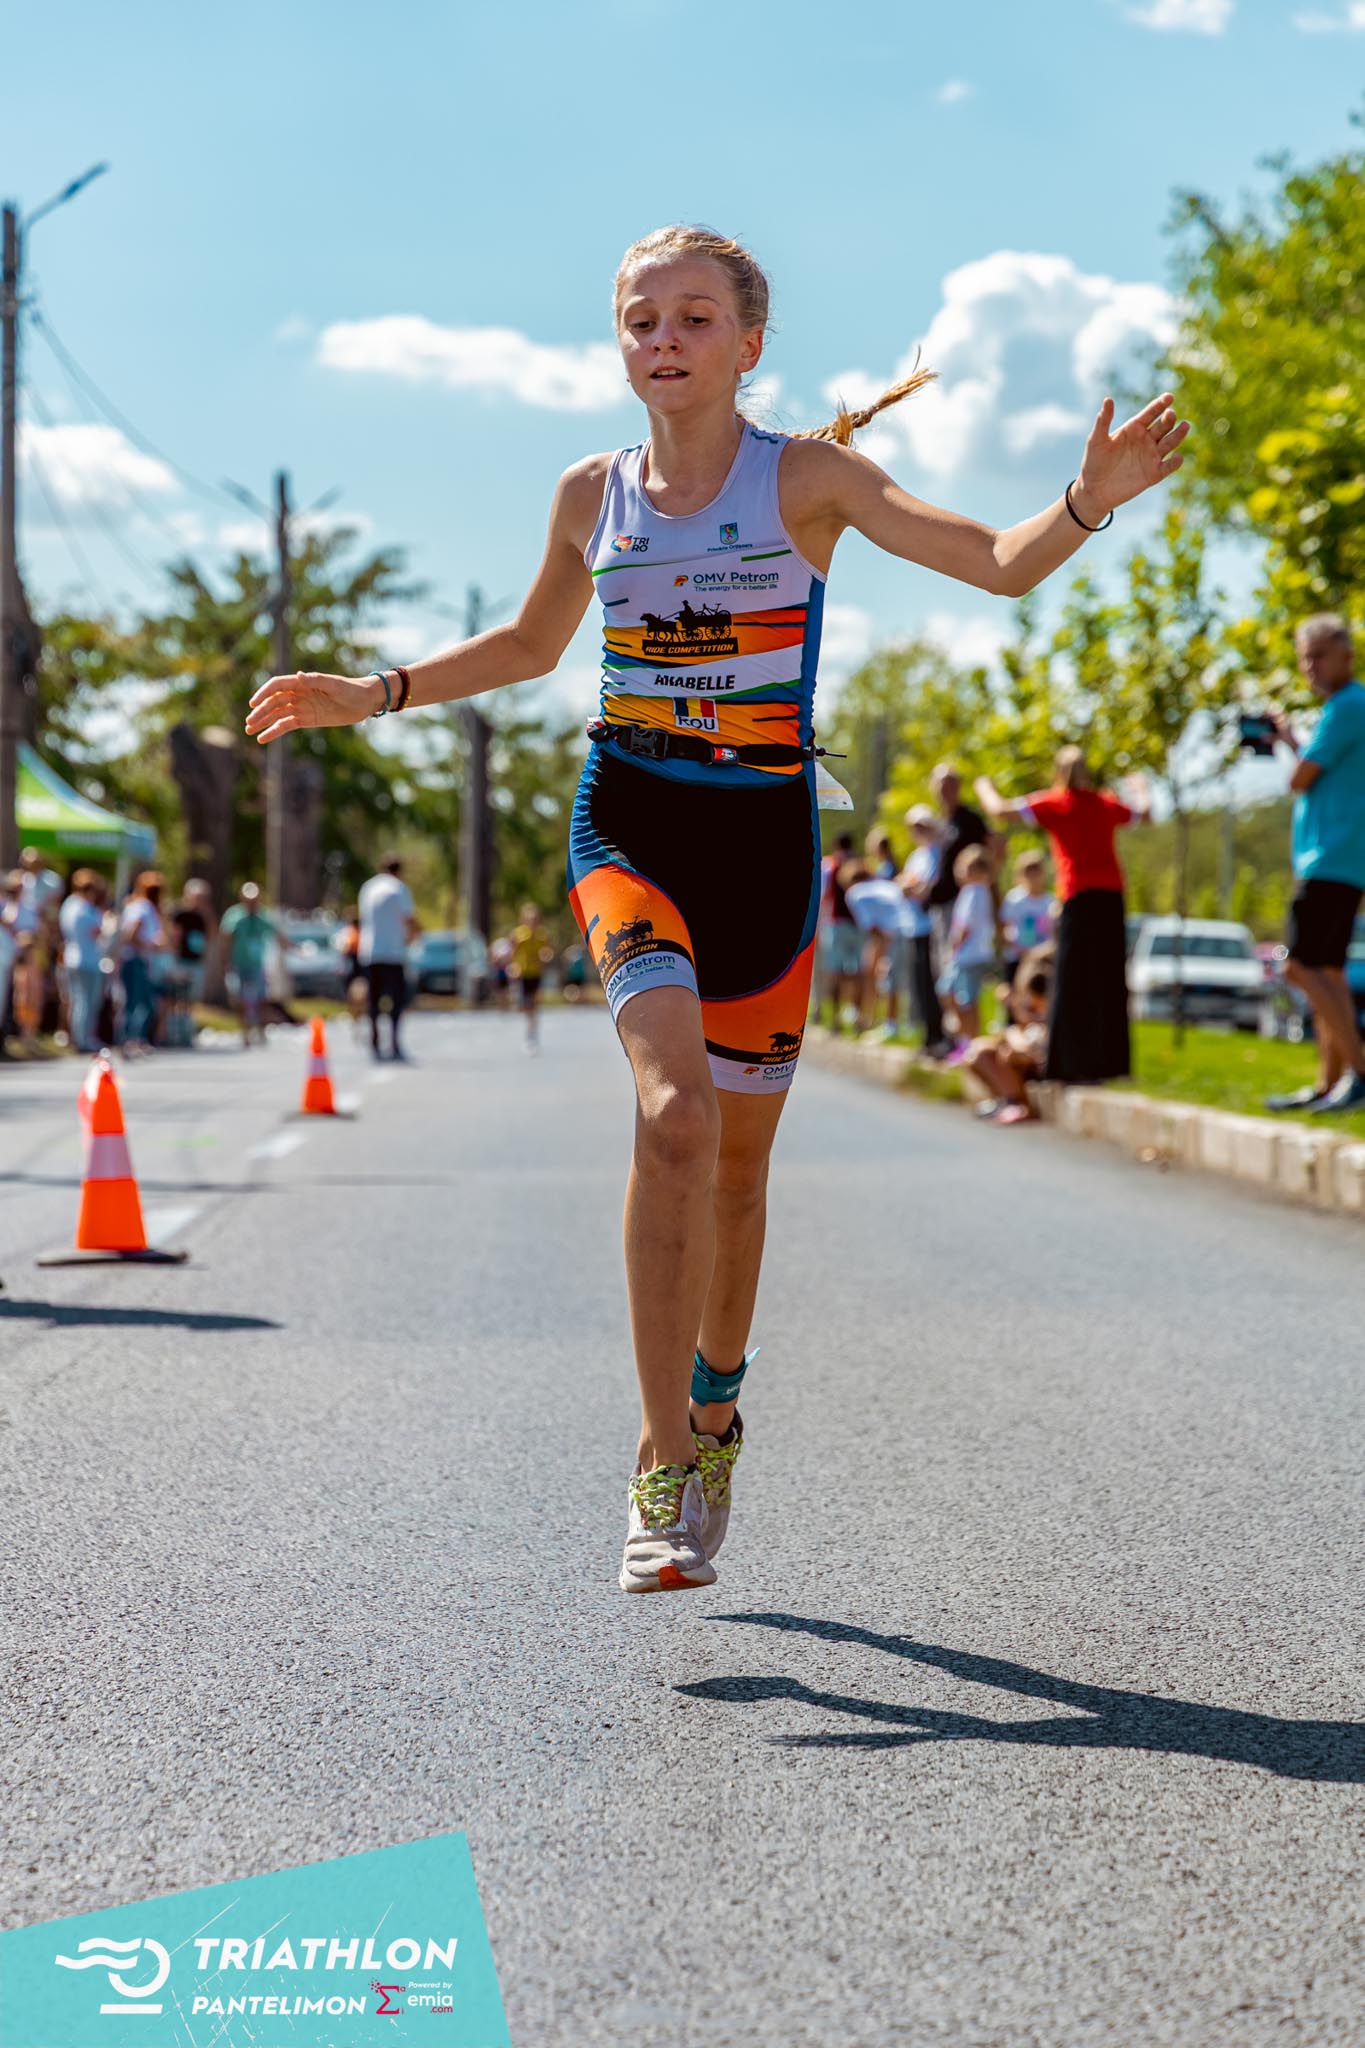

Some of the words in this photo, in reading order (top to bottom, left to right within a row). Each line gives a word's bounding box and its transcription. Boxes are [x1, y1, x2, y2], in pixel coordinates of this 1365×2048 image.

[632, 536, 650, 545] TRI
[631, 545, 649, 553] RO
[693, 572, 726, 584] OMV
[730, 572, 779, 583] Petrom
[645, 646, 666, 654] RIDE
[667, 643, 735, 654] COMPETITION
[678, 716, 715, 730] ROU
[625, 955, 676, 974] Petrom
[763, 1062, 792, 1074] OMV
